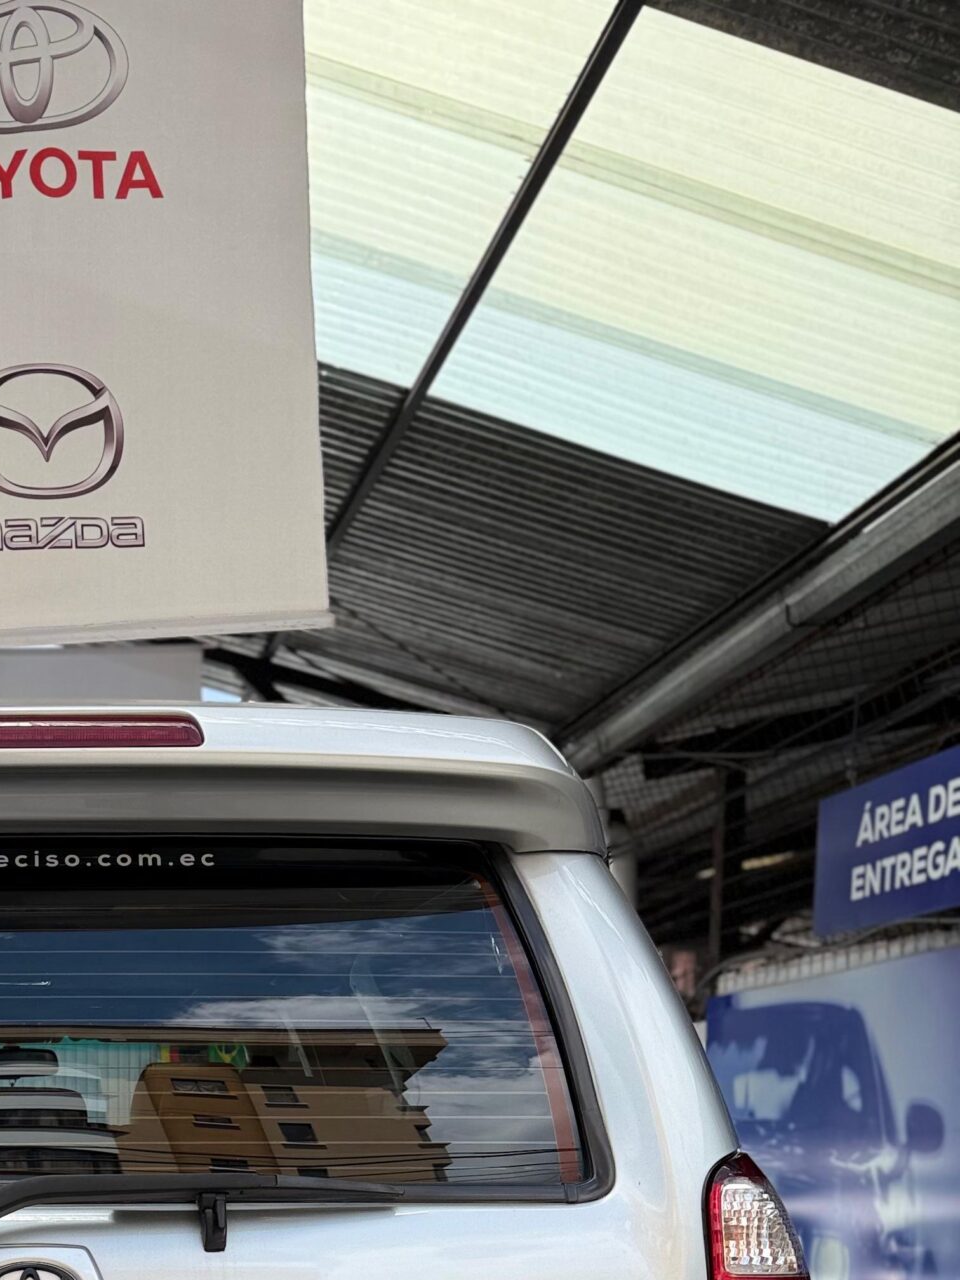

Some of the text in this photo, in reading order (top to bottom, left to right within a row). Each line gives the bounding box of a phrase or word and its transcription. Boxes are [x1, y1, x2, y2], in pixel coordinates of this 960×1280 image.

[855, 776, 960, 848] ÁREA DE
[850, 835, 960, 901] ENTREGA
